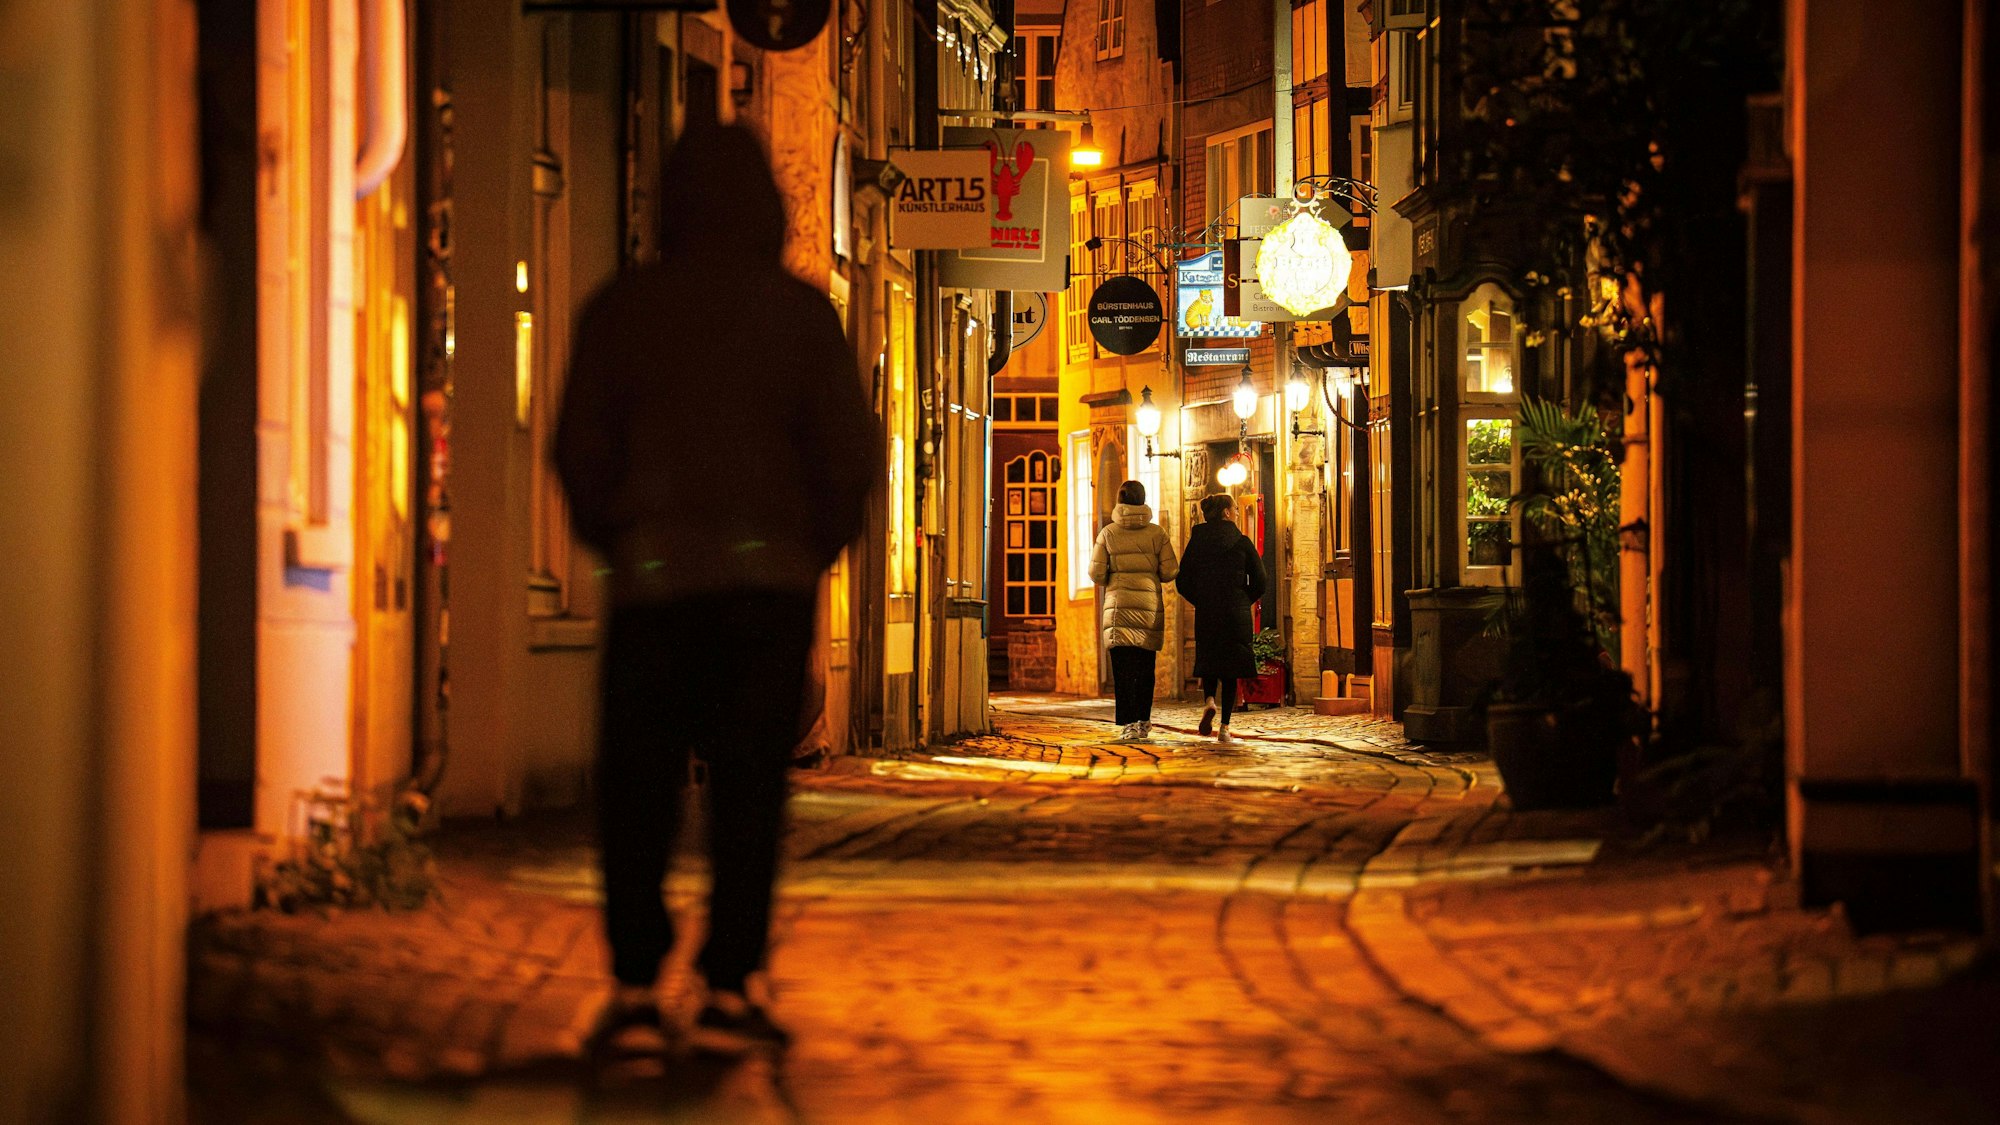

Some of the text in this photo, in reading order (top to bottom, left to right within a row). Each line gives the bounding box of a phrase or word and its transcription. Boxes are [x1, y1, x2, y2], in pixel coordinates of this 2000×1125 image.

[899, 177, 985, 201] ART15
[899, 202, 985, 213] KÜNSTLERHAUS
[1097, 302, 1154, 310] BÜRSTENHAUS
[1253, 303, 1274, 311] Bistro
[1091, 315, 1160, 324] CARL TÖDDENSEN
[1187, 351, 1249, 363] Restaurant
